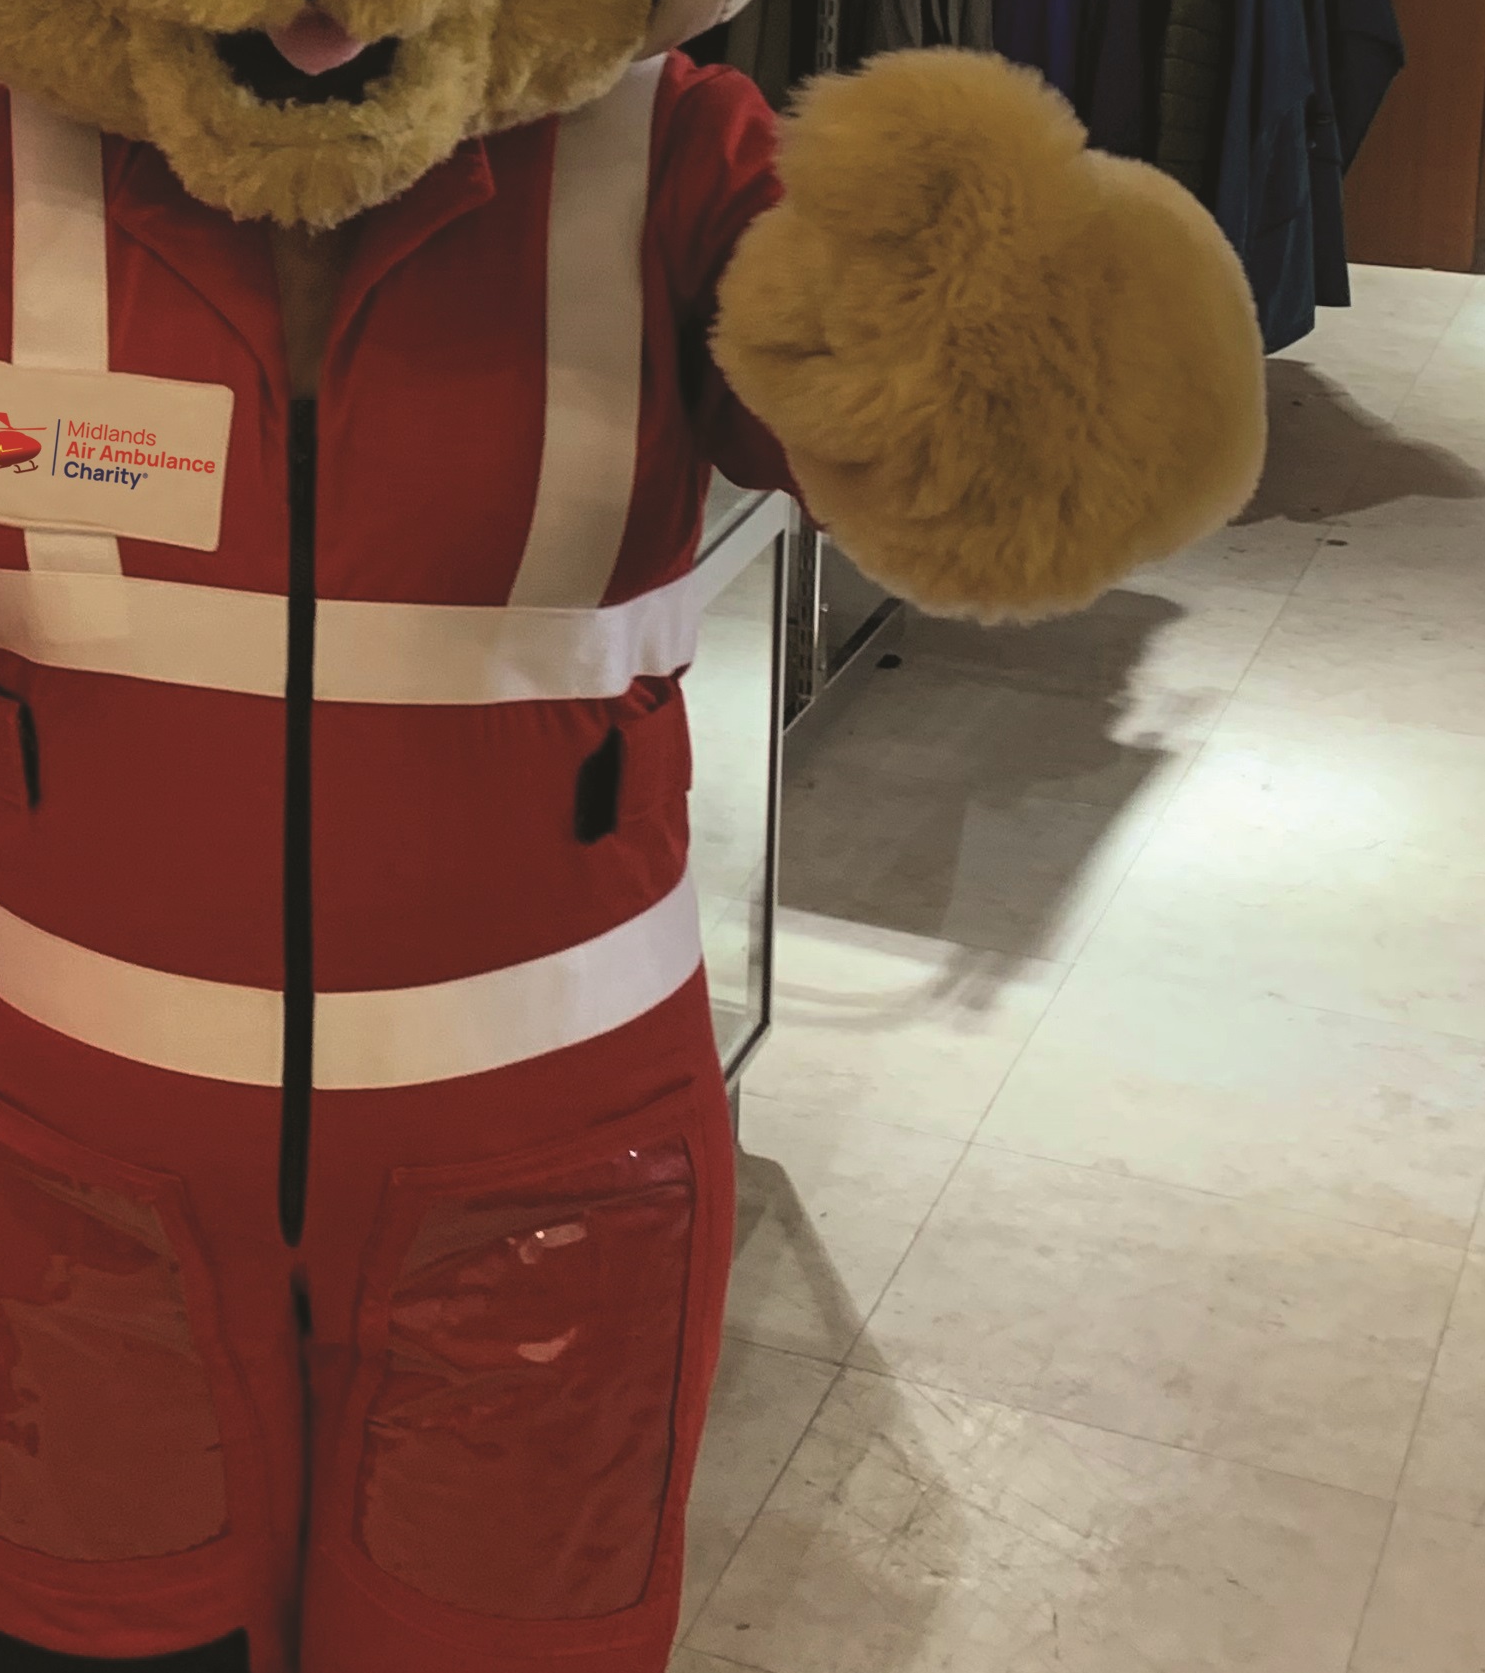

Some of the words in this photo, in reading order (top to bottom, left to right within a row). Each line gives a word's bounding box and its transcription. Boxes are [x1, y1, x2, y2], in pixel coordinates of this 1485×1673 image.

[67, 420, 157, 447] Midlands
[65, 441, 96, 460] Air
[99, 445, 216, 474] Ambulance
